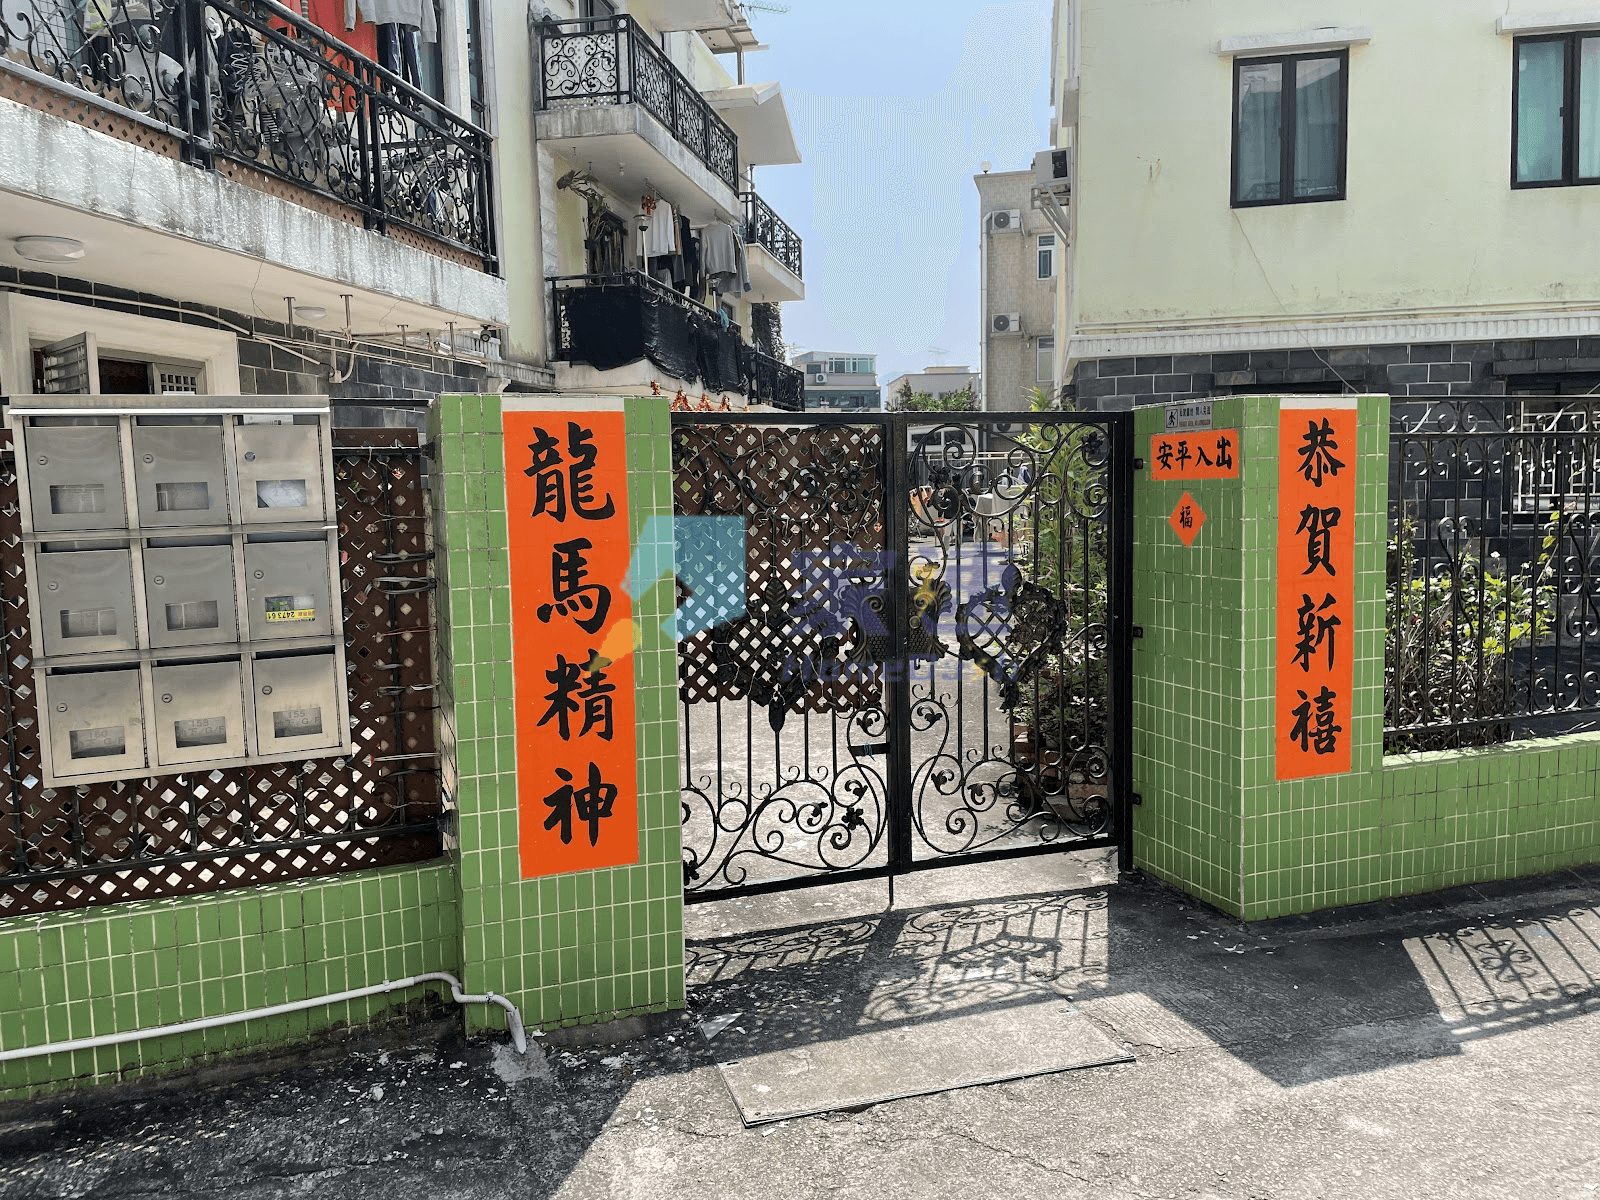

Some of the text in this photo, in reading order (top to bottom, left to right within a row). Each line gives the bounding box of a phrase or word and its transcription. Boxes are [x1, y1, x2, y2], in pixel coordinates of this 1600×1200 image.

[523, 421, 619, 847] 龍馬精神
[1179, 505, 1193, 529] 福
[1290, 417, 1346, 755] 恭賀新禧
